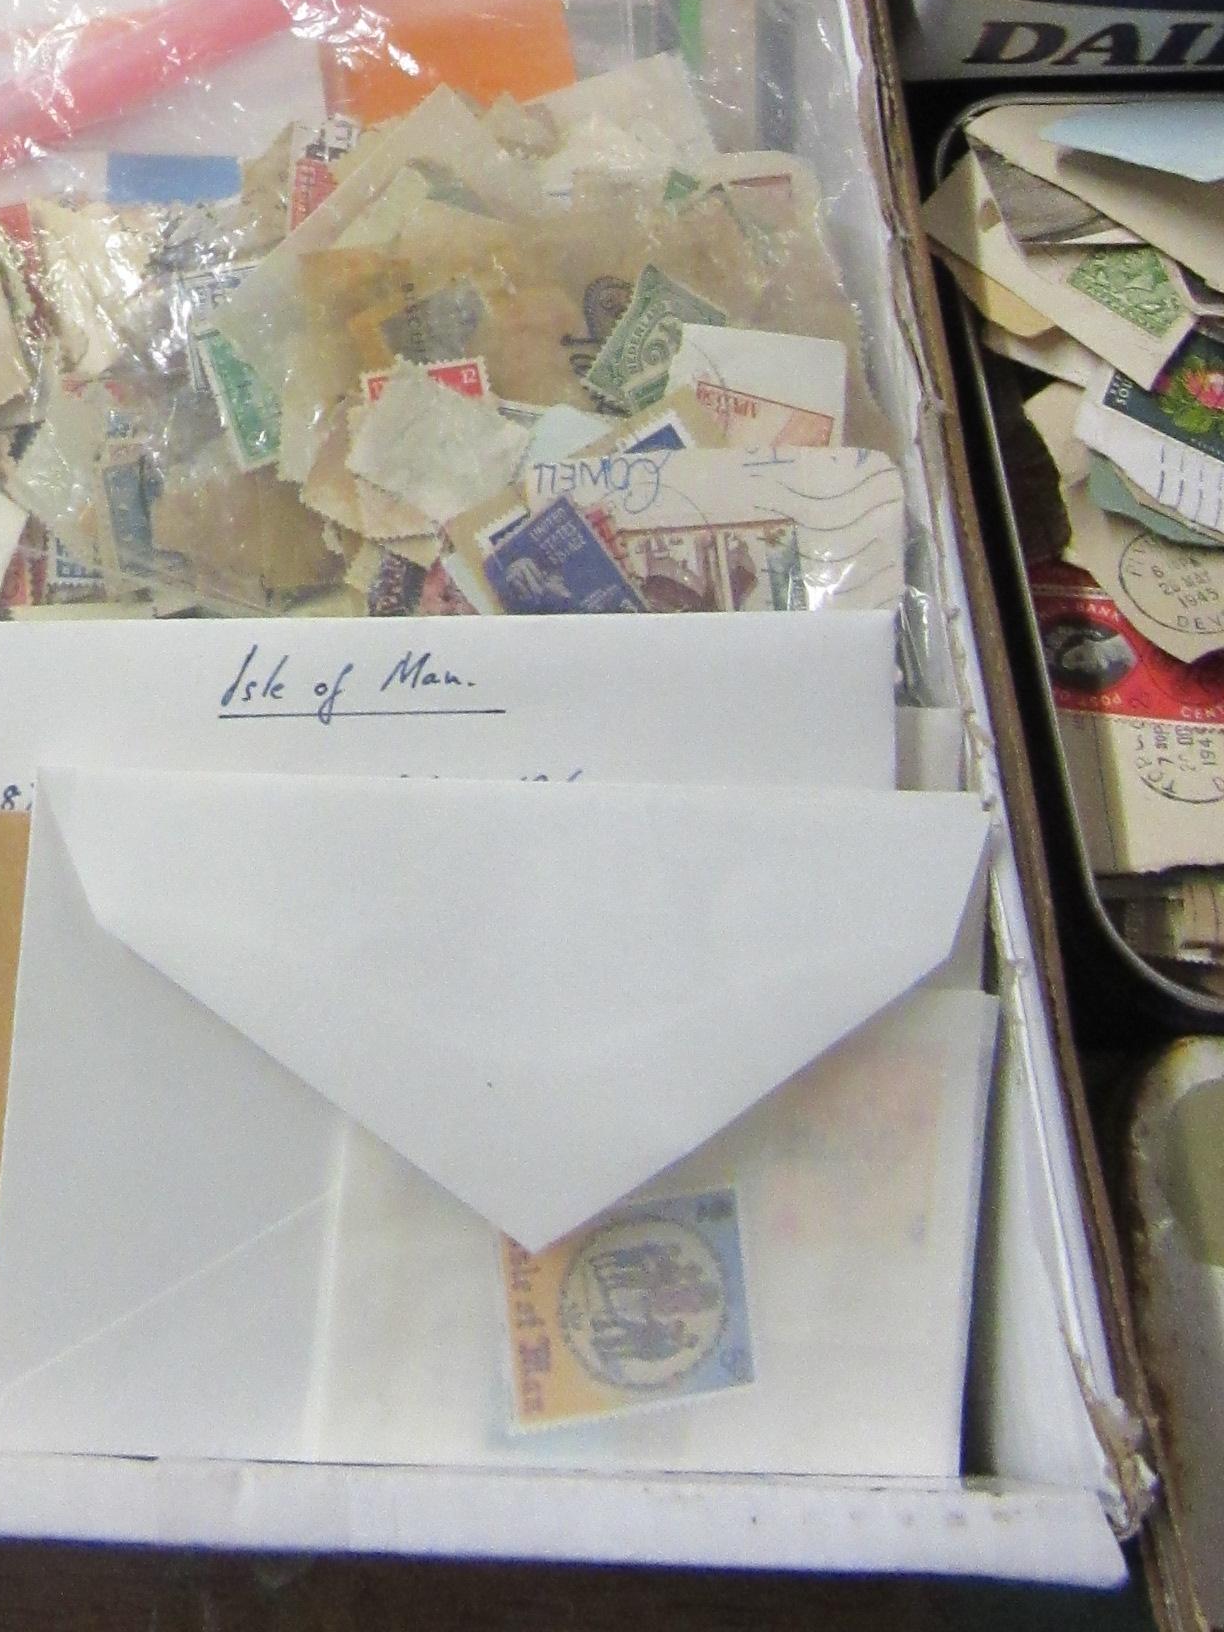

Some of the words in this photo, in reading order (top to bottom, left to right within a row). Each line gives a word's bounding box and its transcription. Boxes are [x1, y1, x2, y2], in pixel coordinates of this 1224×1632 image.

[1176, 612, 1224, 630] DEV
[220, 644, 288, 707] Isle
[314, 662, 354, 726] of
